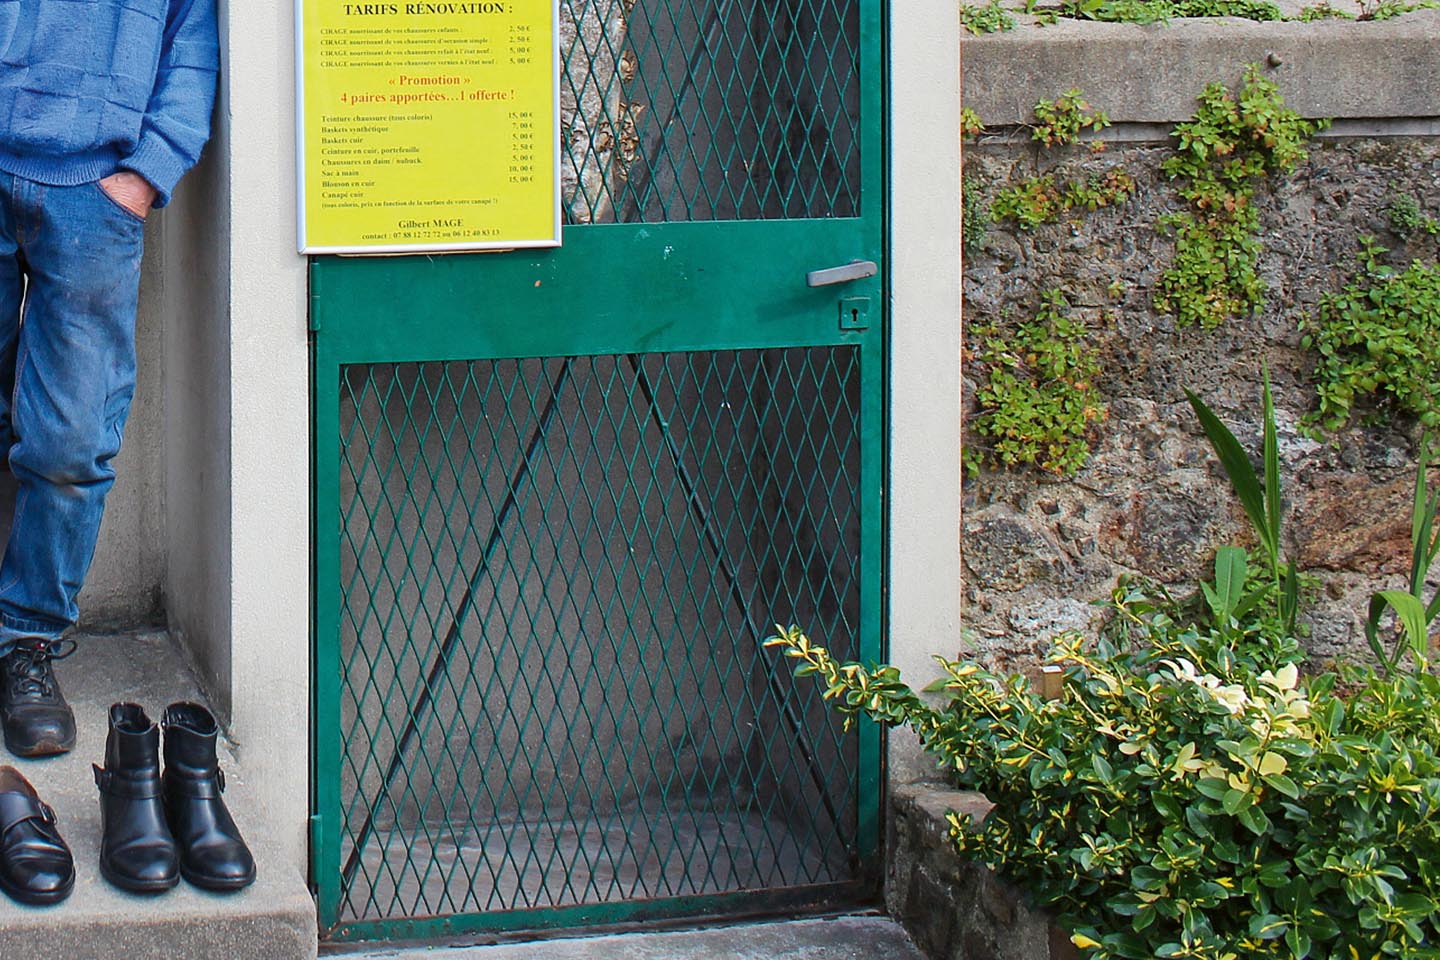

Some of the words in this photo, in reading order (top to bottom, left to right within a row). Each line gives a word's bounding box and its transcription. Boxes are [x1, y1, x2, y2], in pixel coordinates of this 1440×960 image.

[343, 4, 398, 16] TARIFS
[406, 1, 505, 15] RÉNOVATION
[399, 75, 460, 86] Promotion
[340, 93, 348, 103] 4
[351, 92, 386, 106] paires
[469, 89, 507, 101] offerte
[398, 220, 430, 229] Gilbert
[432, 218, 464, 228] MAGE
[362, 232, 387, 240] contact
